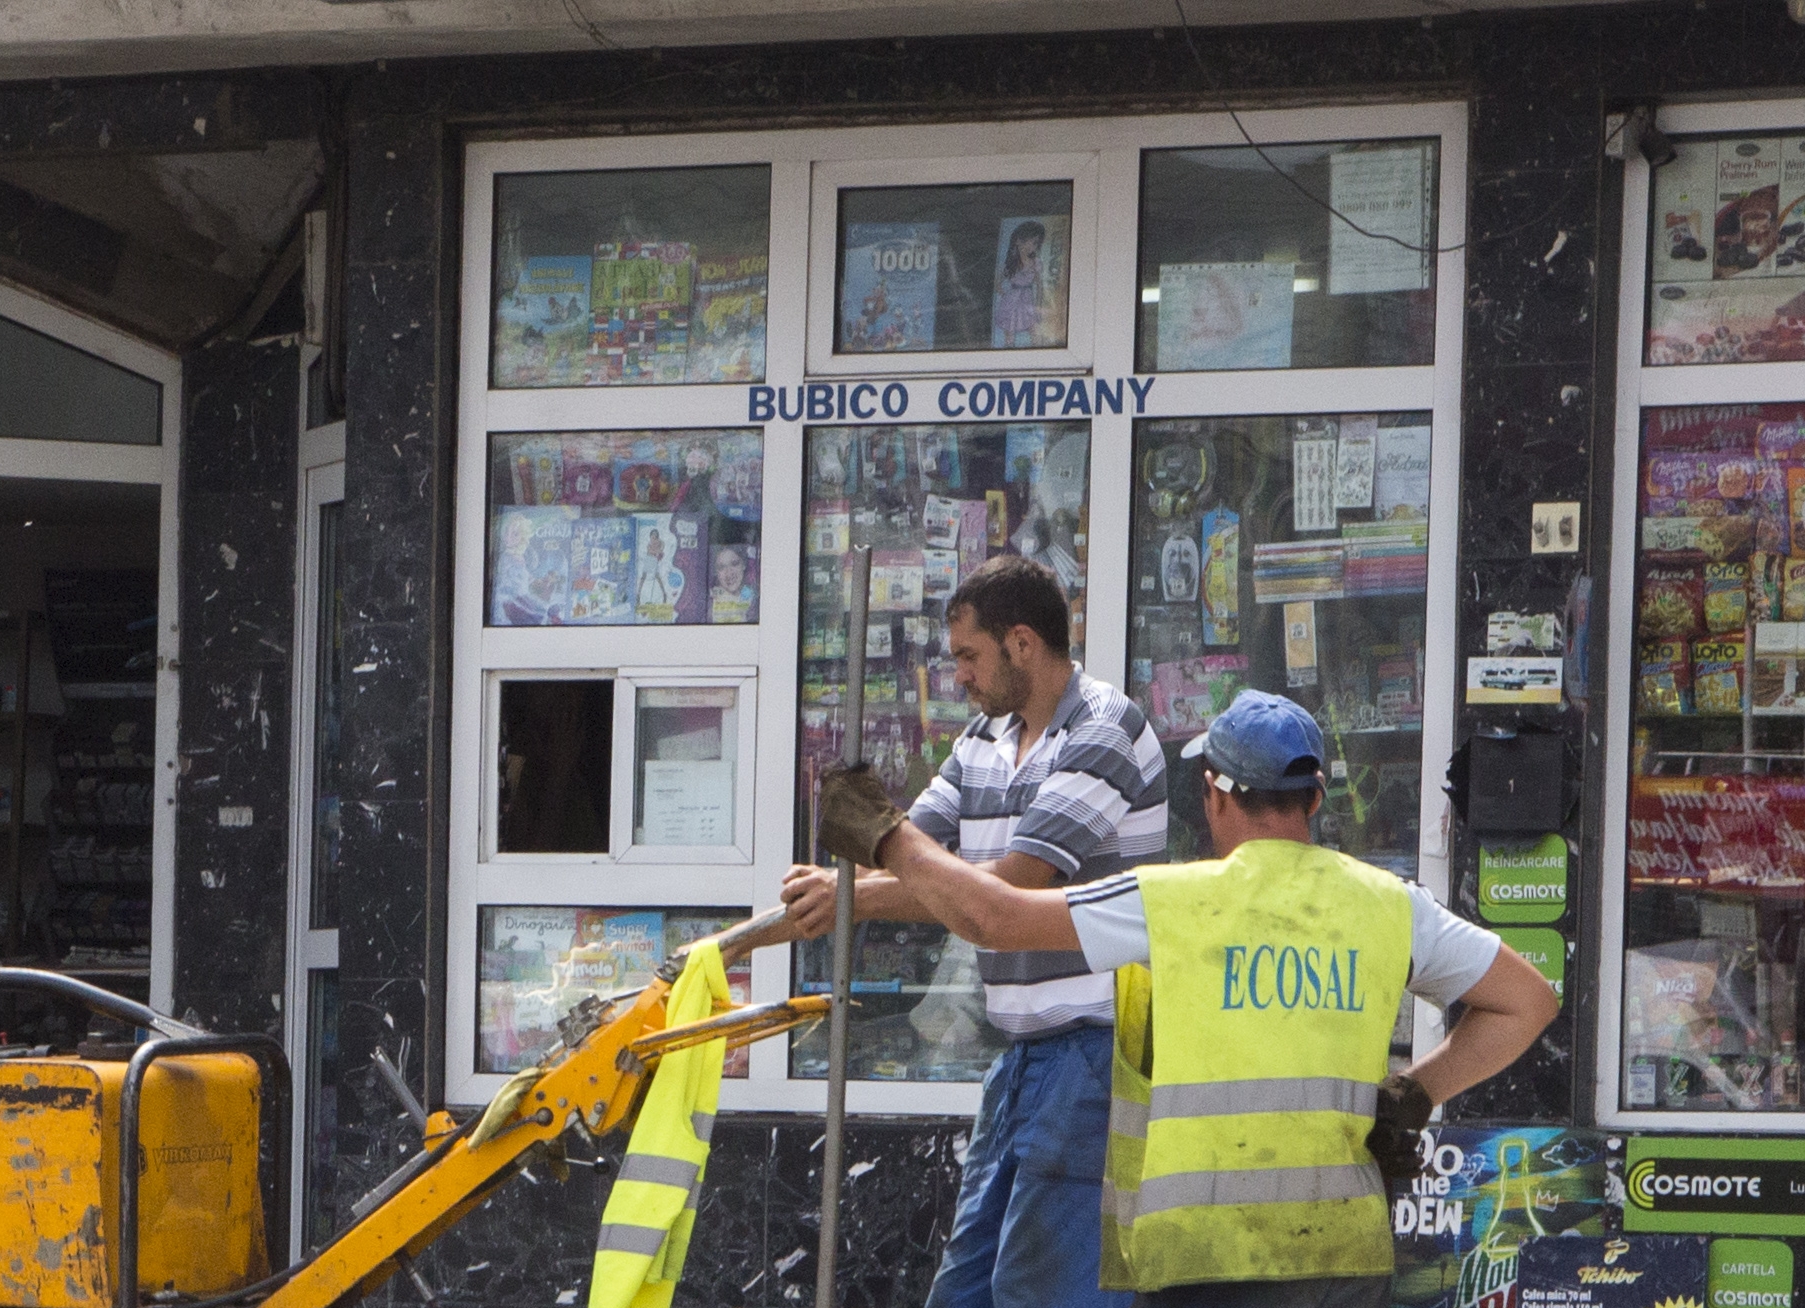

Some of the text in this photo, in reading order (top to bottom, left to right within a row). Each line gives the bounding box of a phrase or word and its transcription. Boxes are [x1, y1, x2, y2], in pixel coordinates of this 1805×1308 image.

[1754, 159, 1777, 169] Rum
[872, 249, 931, 272] 1000
[748, 376, 1155, 423] BUBICO COMPANY
[1696, 644, 1737, 662] LOTTO
[1489, 884, 1566, 899] COSMOTE
[609, 922, 649, 940] Super
[1220, 944, 1365, 1013] ECOSAL
[1411, 1172, 1451, 1196] the
[1642, 1174, 1761, 1198] COSMOTE
[1394, 1196, 1464, 1236] DEW
[1577, 1265, 1643, 1285] Tchibo
[1721, 1263, 1776, 1276] CARTELA
[1523, 1289, 1591, 1301] Cafea mica 70 ml
[1714, 1289, 1791, 1308] COSMOTE
